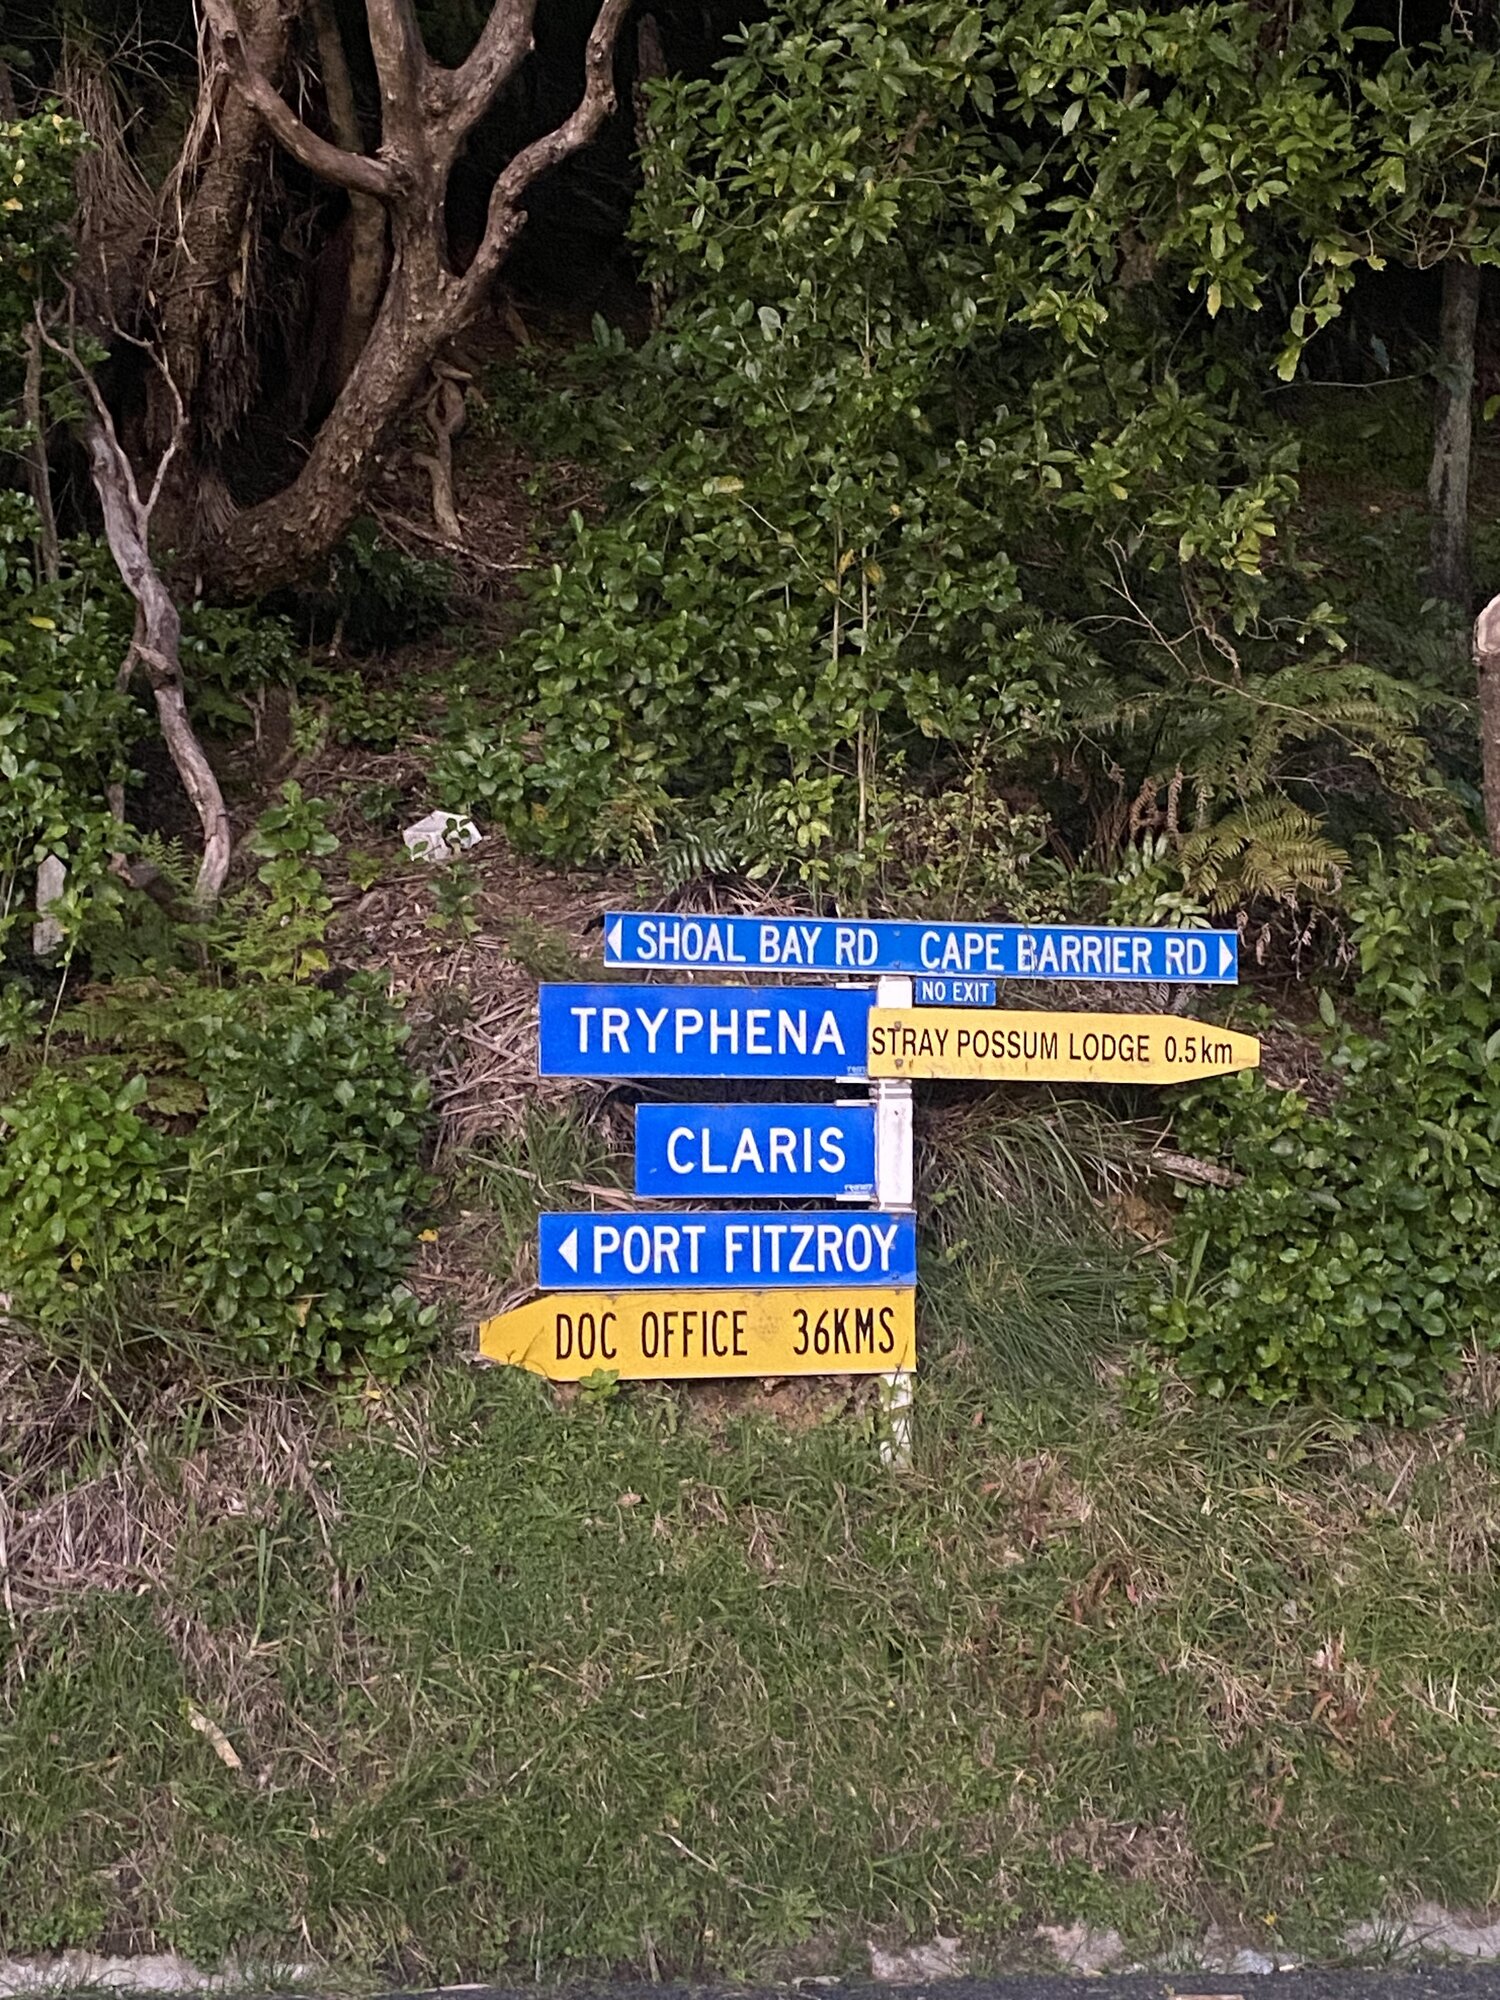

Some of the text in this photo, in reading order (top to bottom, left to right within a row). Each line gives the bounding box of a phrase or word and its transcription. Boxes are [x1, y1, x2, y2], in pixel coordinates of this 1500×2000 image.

[636, 921, 879, 966] SHOAL BAY RD
[920, 931, 1207, 976] CAPE BARRIER RD
[922, 981, 989, 1002] NO EXIT
[570, 1007, 846, 1055] TRYPHENA
[871, 1027, 1233, 1065] STRAY POSSUM LODGE 0.5km
[666, 1126, 846, 1175] CLARIS
[593, 1224, 899, 1275] PORT FITZROY
[555, 1306, 896, 1360] DOC OFFICE 36KMS
